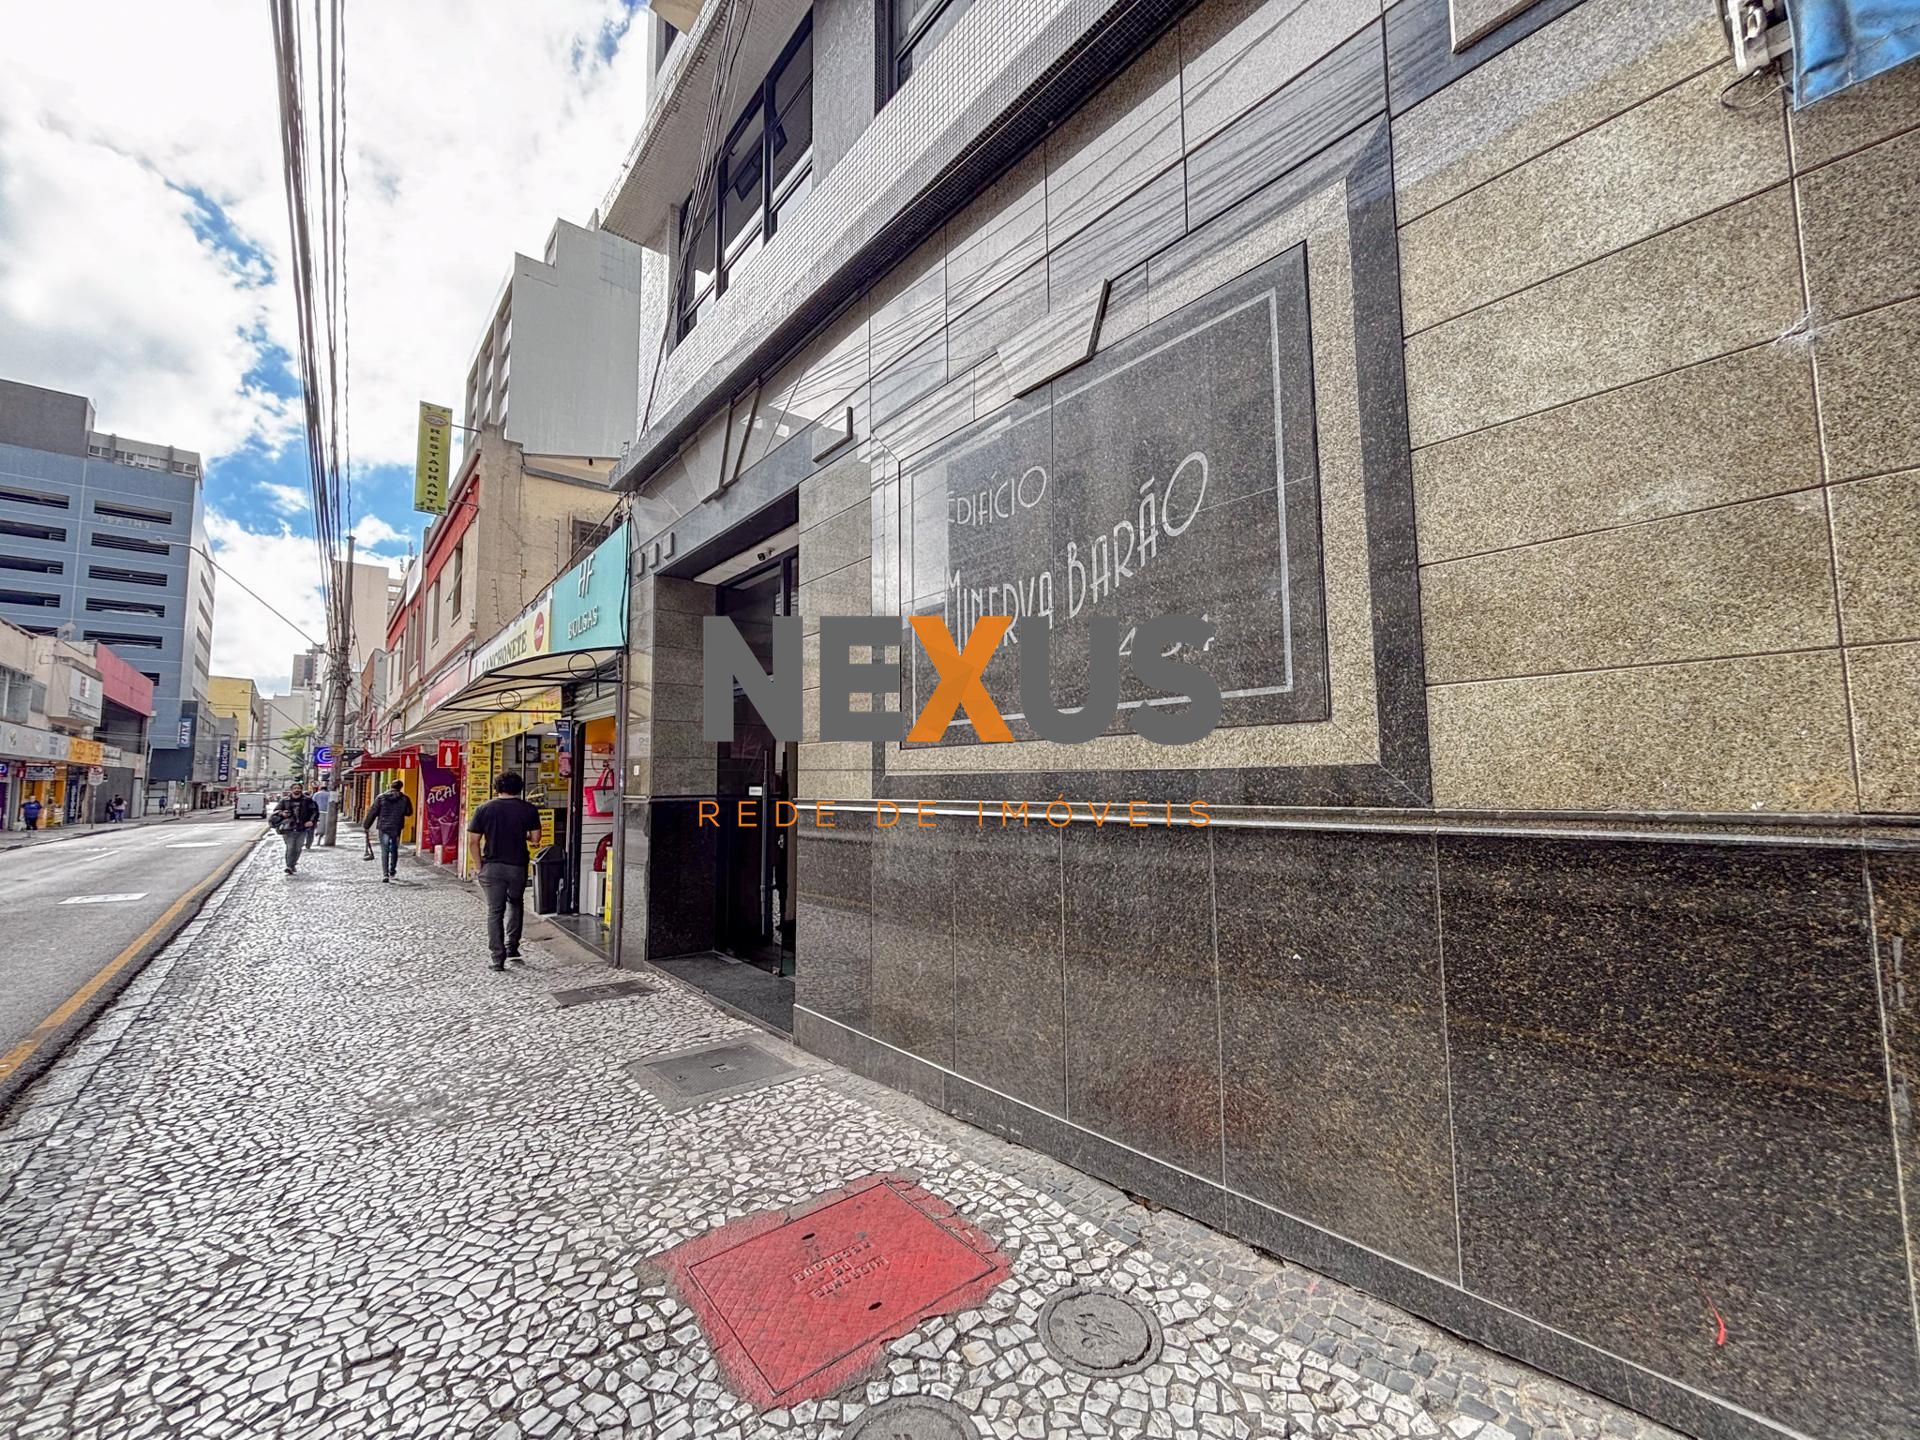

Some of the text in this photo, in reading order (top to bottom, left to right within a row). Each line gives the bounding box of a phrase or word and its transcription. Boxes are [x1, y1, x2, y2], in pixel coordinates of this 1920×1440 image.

[424, 428, 441, 511] RESTAURANTE
[946, 465, 1047, 526] EDIFÍCIO
[1066, 451, 1209, 619] BARÃO
[568, 606, 599, 640] BOLSAS
